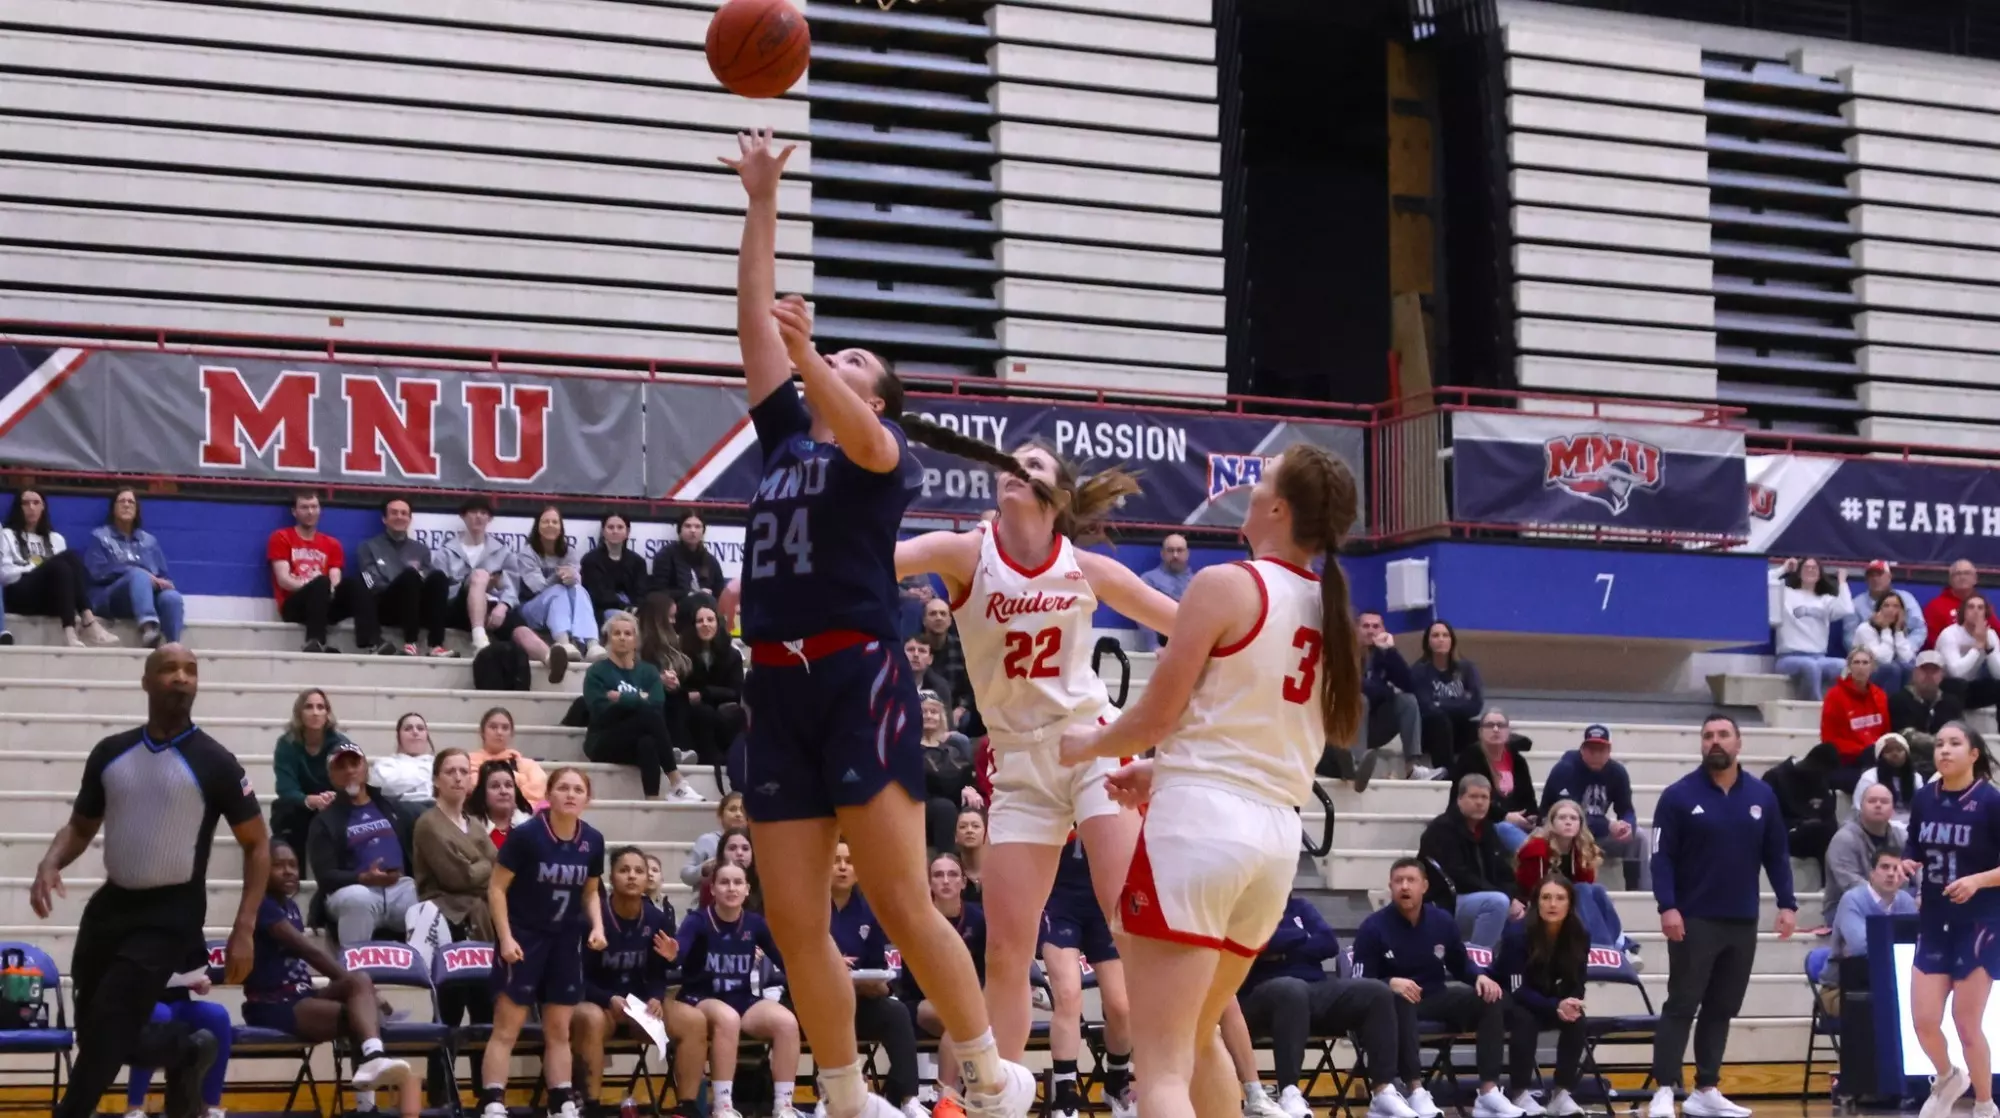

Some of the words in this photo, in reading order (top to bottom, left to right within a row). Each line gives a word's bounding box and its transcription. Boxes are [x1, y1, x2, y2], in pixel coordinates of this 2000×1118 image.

[200, 365, 552, 483] MNU
[1055, 420, 1187, 463] PASSION
[752, 456, 830, 503] MNU
[1208, 452, 1272, 500] NA
[1546, 434, 1662, 490] MNU
[921, 469, 992, 499] POR
[1840, 497, 2000, 537] #FEARTH
[751, 507, 813, 579] 24
[985, 591, 1078, 623] Raiders
[1595, 572, 1615, 611] 7
[1003, 626, 1062, 679] 22
[1282, 625, 1322, 705] 3
[1919, 821, 1971, 846] MNU
[537, 862, 588, 886] MNU
[1926, 849, 1957, 884] 21
[552, 890, 570, 922] 7
[345, 946, 413, 970] MNU
[704, 952, 751, 974] MNU
[1588, 948, 1622, 968] NU
